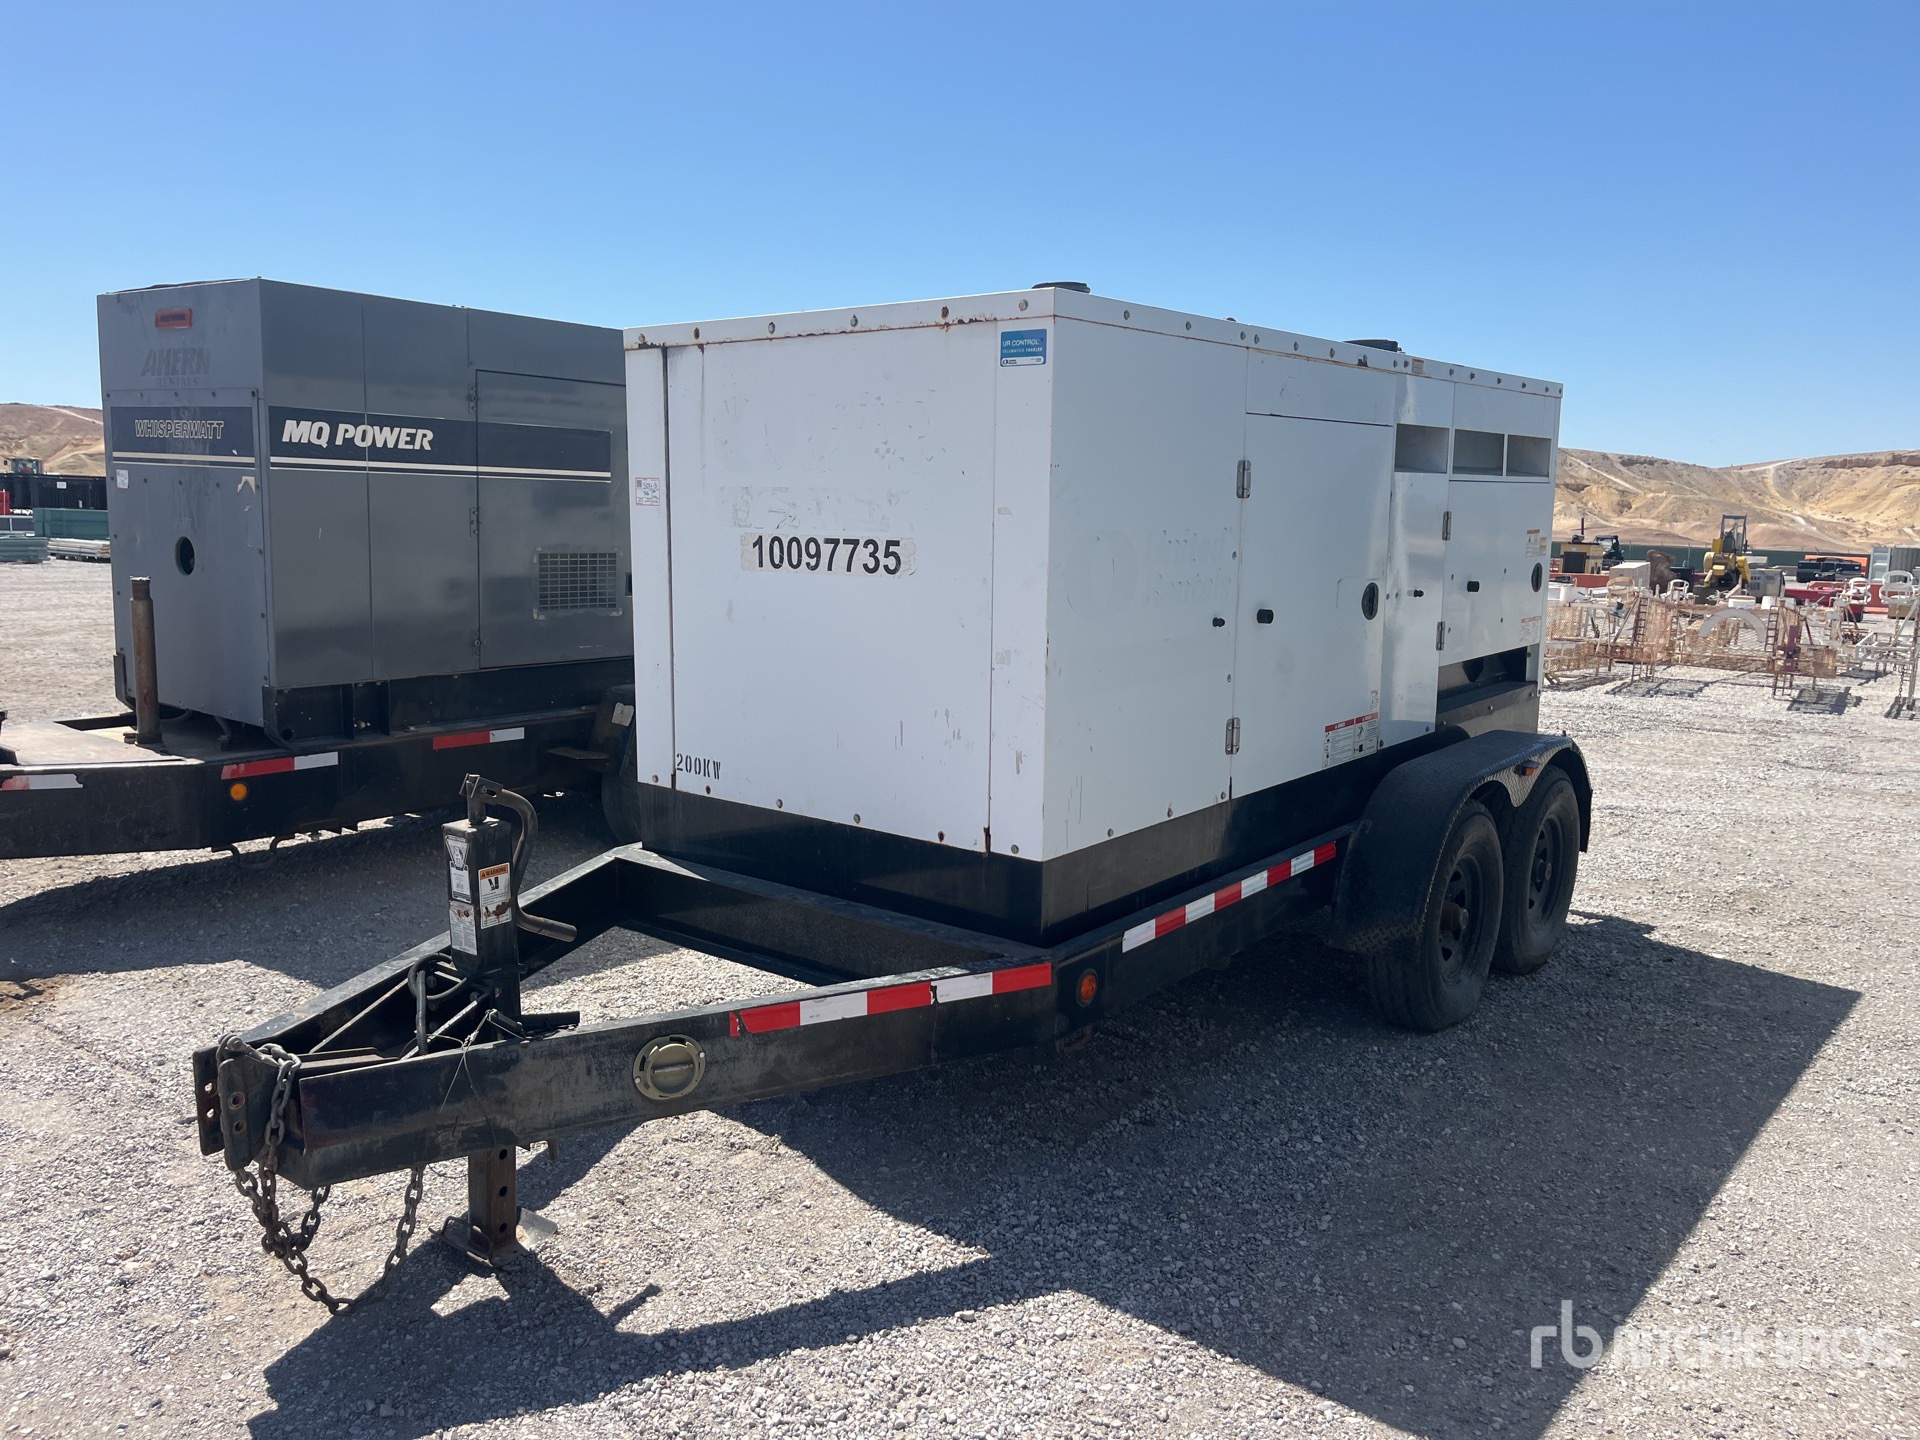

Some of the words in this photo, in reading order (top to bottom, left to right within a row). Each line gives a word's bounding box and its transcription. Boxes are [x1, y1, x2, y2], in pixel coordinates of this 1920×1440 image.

[141, 346, 211, 377] AHERN
[156, 376, 199, 387] RENTALS
[134, 419, 224, 439] WHISPERWATT
[281, 419, 331, 448] MQ
[335, 423, 434, 450] POWER
[752, 535, 902, 575] 10097735
[676, 752, 721, 780] 200KW
